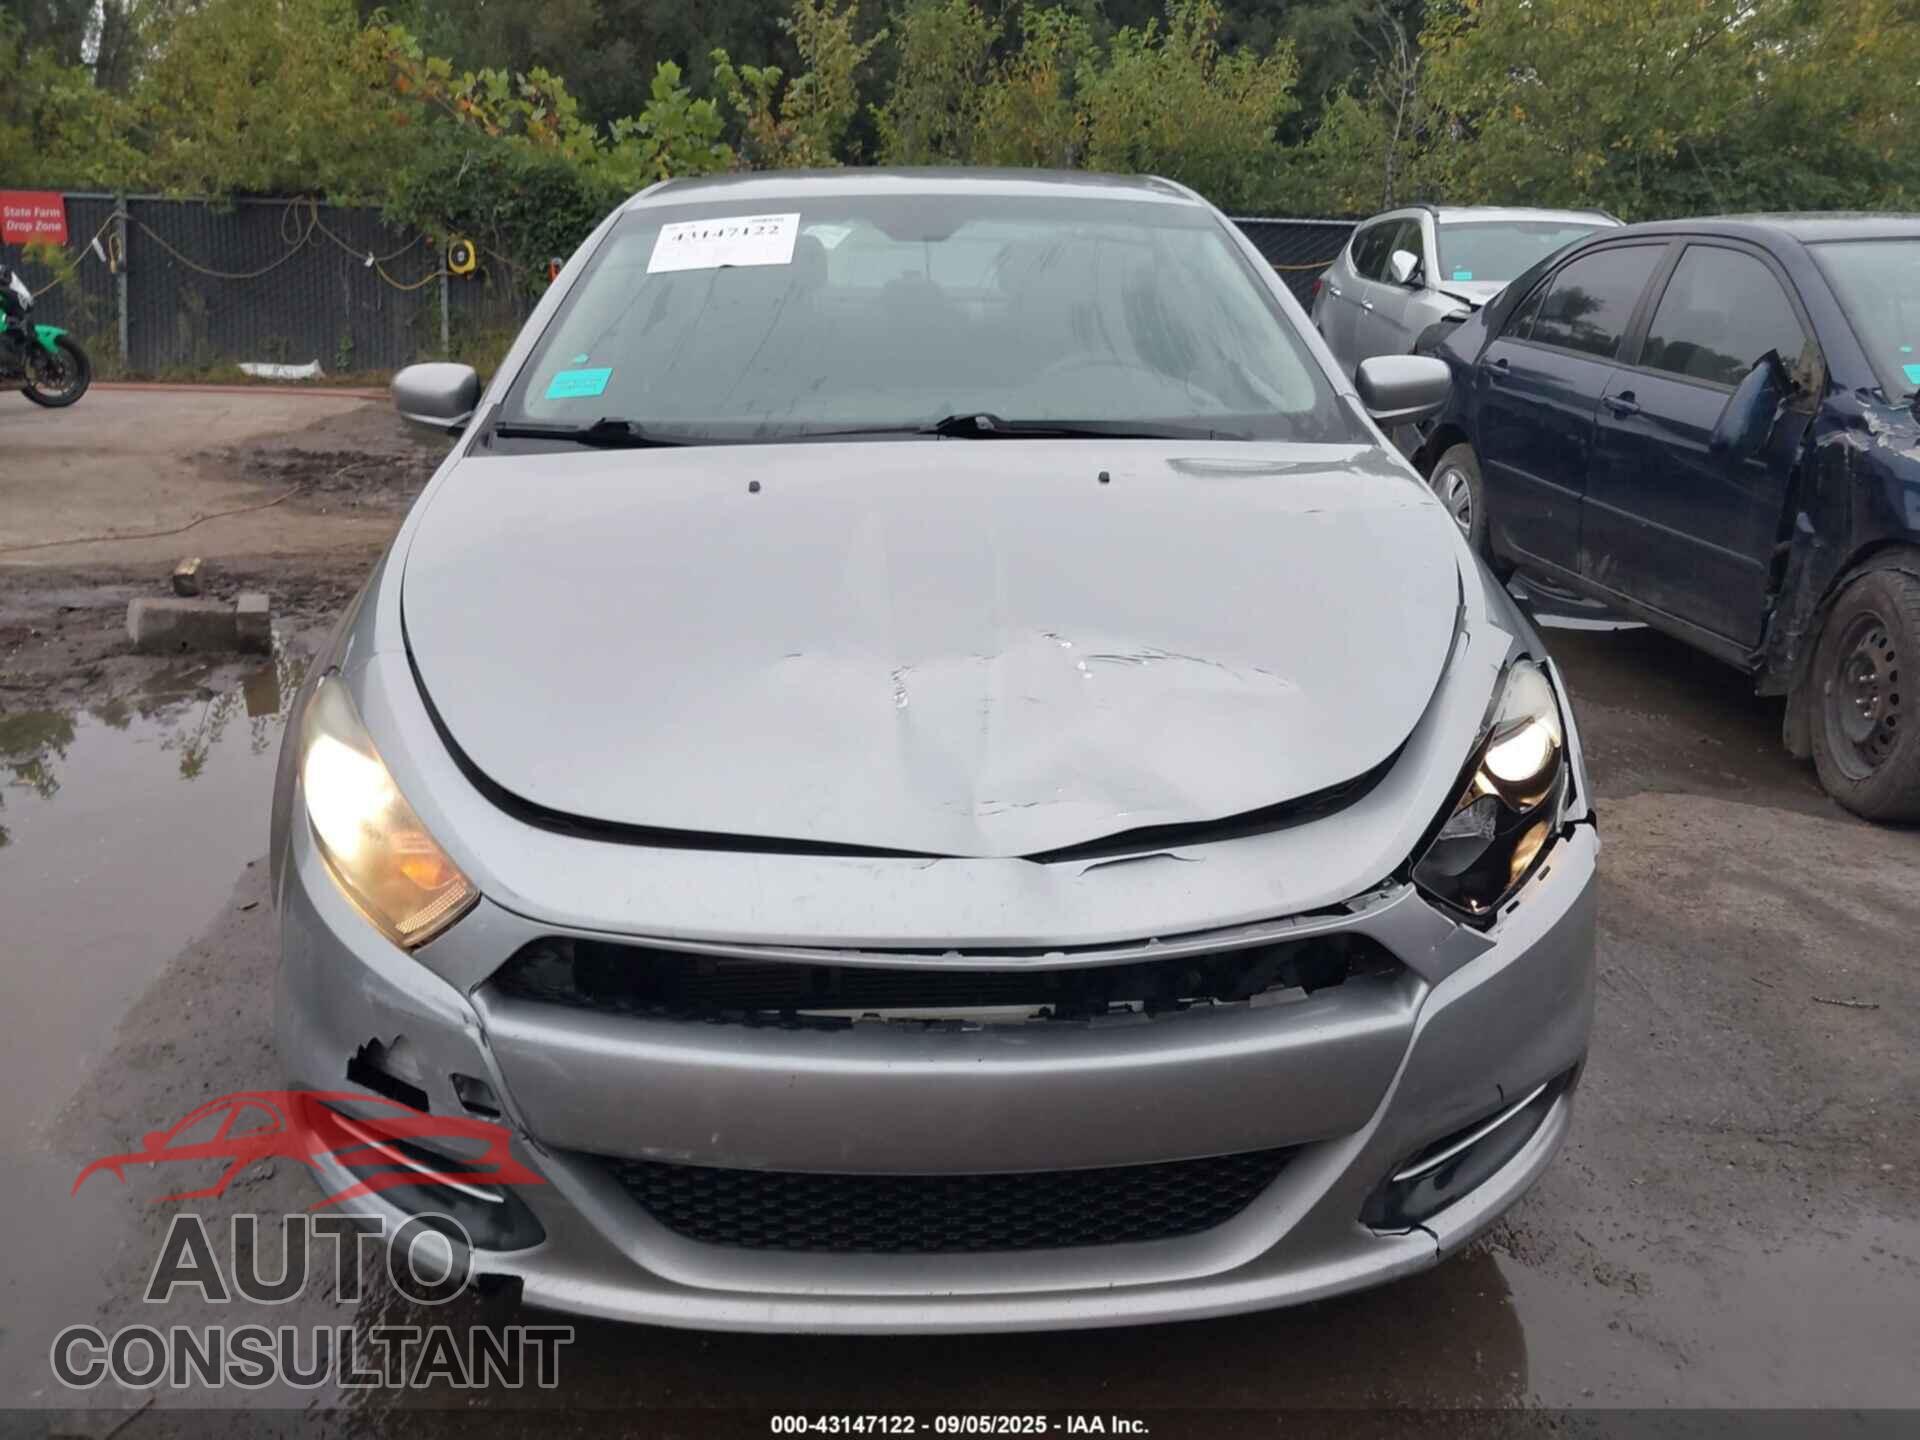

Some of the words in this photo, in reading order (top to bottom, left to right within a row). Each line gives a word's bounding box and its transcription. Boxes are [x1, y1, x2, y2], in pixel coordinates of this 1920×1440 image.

[4, 206, 32, 217] State
[34, 207, 61, 217] Farm
[6, 219, 33, 232] Drop
[35, 220, 62, 232] Zone
